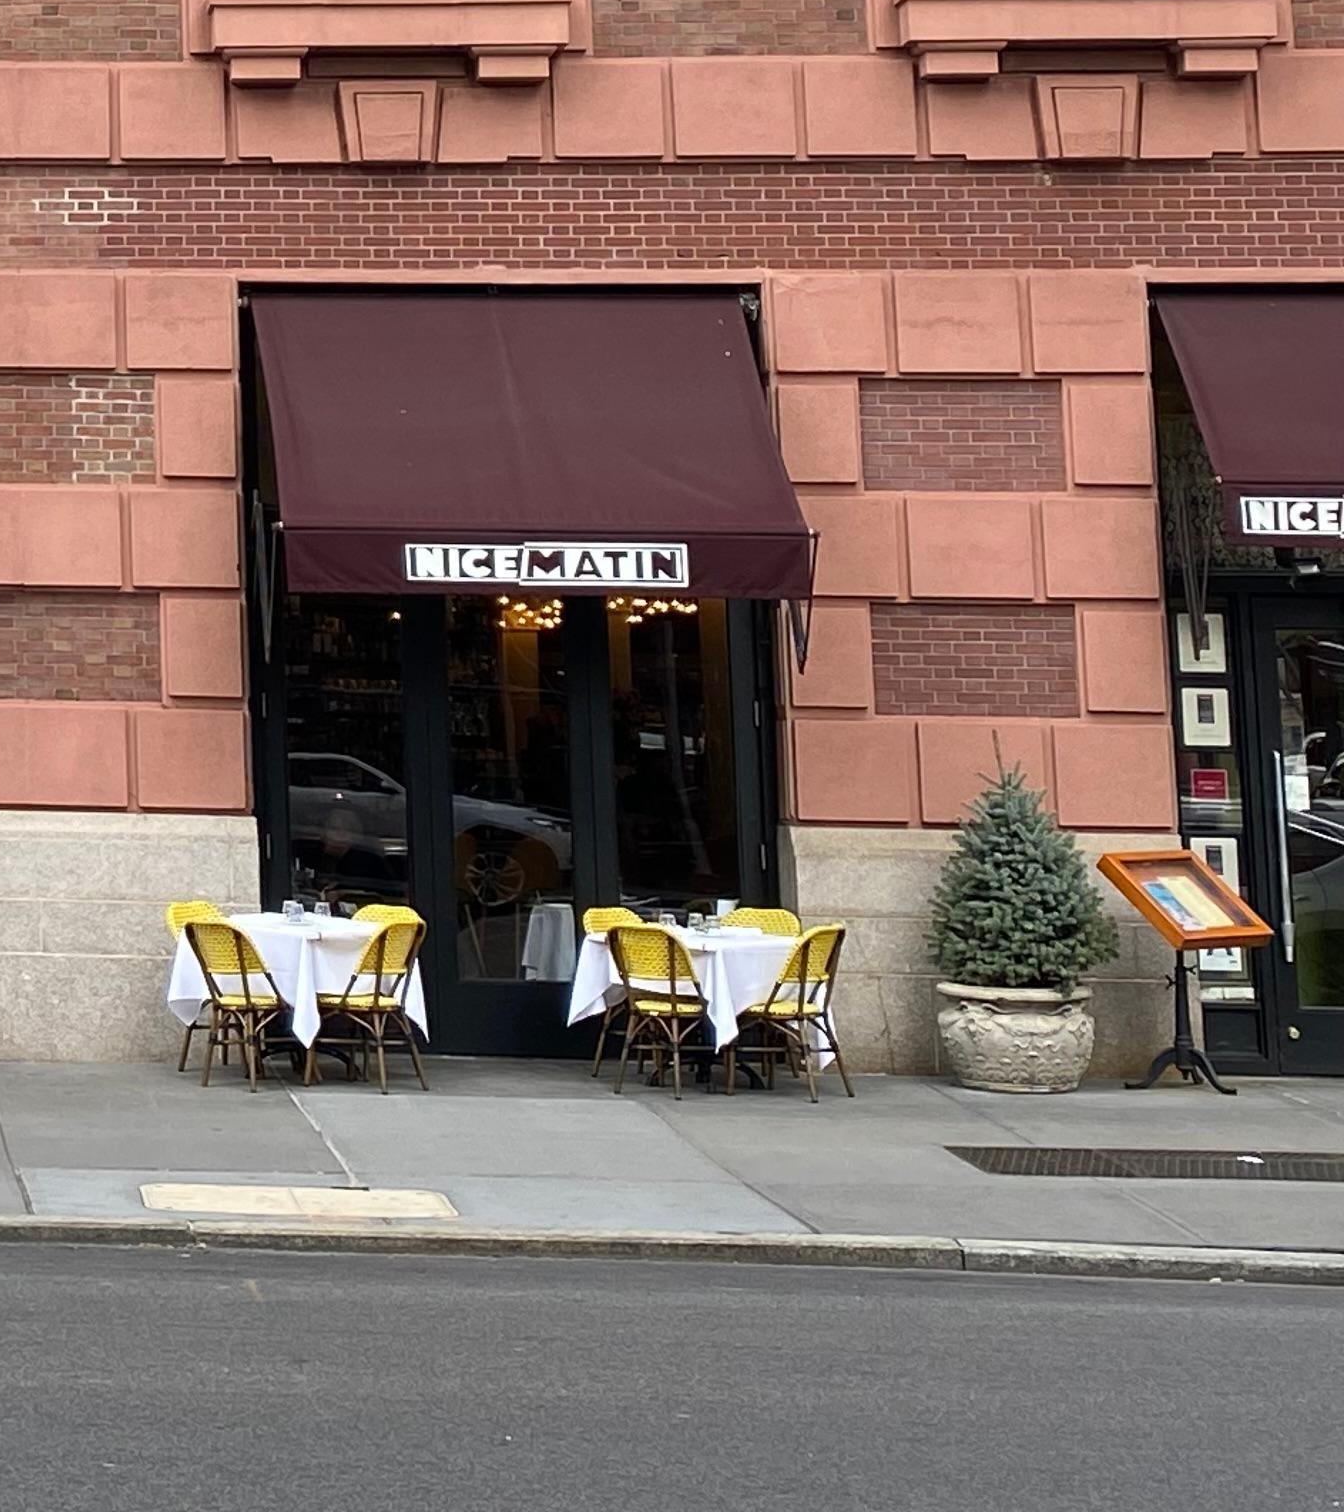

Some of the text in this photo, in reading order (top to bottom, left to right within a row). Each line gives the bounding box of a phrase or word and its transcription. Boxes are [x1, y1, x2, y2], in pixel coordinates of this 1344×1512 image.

[1249, 500, 1340, 532] NICE
[413, 547, 679, 580] NICE MATIN
